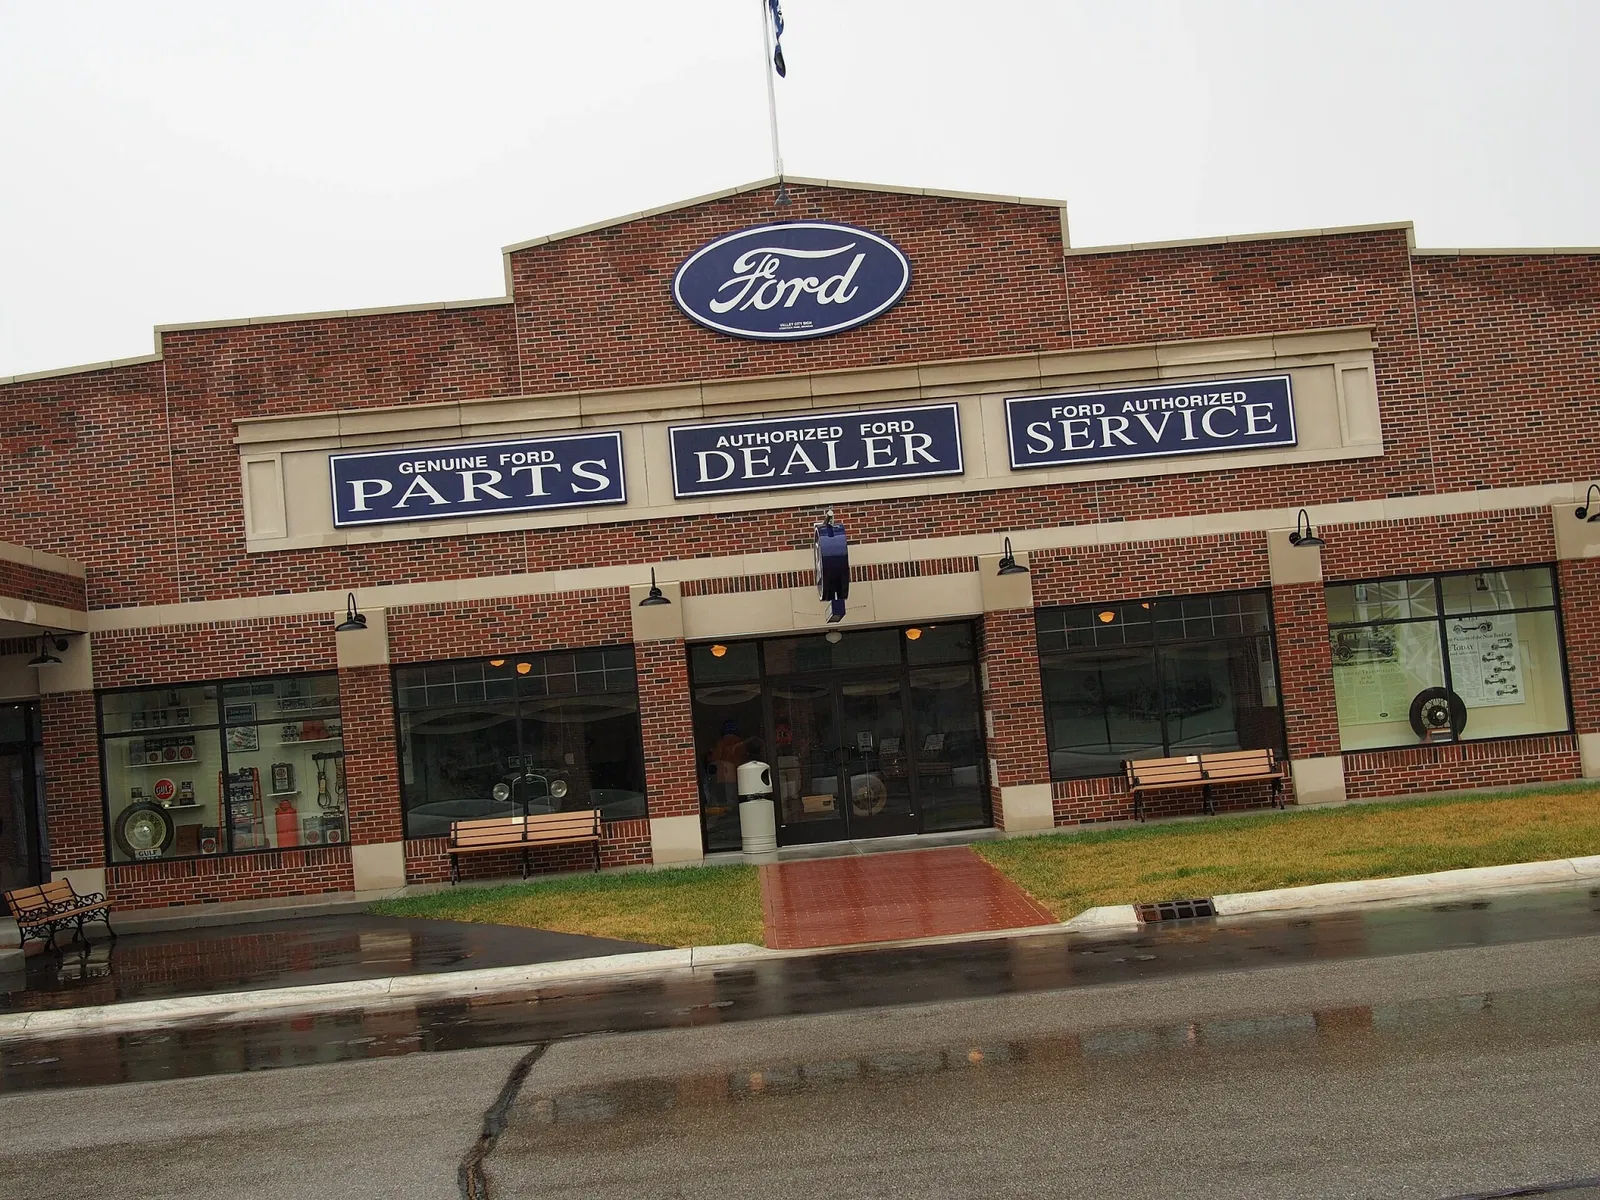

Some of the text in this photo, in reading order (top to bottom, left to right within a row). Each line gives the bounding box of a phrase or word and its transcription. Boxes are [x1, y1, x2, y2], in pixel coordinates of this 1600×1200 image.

[709, 242, 866, 314] Ford
[1051, 391, 1247, 419] FORD AUTHORIZED
[716, 420, 915, 448] AUTHORIZED FORD
[1026, 402, 1278, 455] SERVICE
[398, 450, 555, 474] GENUINE FORD
[693, 433, 940, 483] DEALER
[346, 458, 611, 513] PARTS
[155, 784, 173, 796] GULF
[138, 849, 157, 858] GULF
